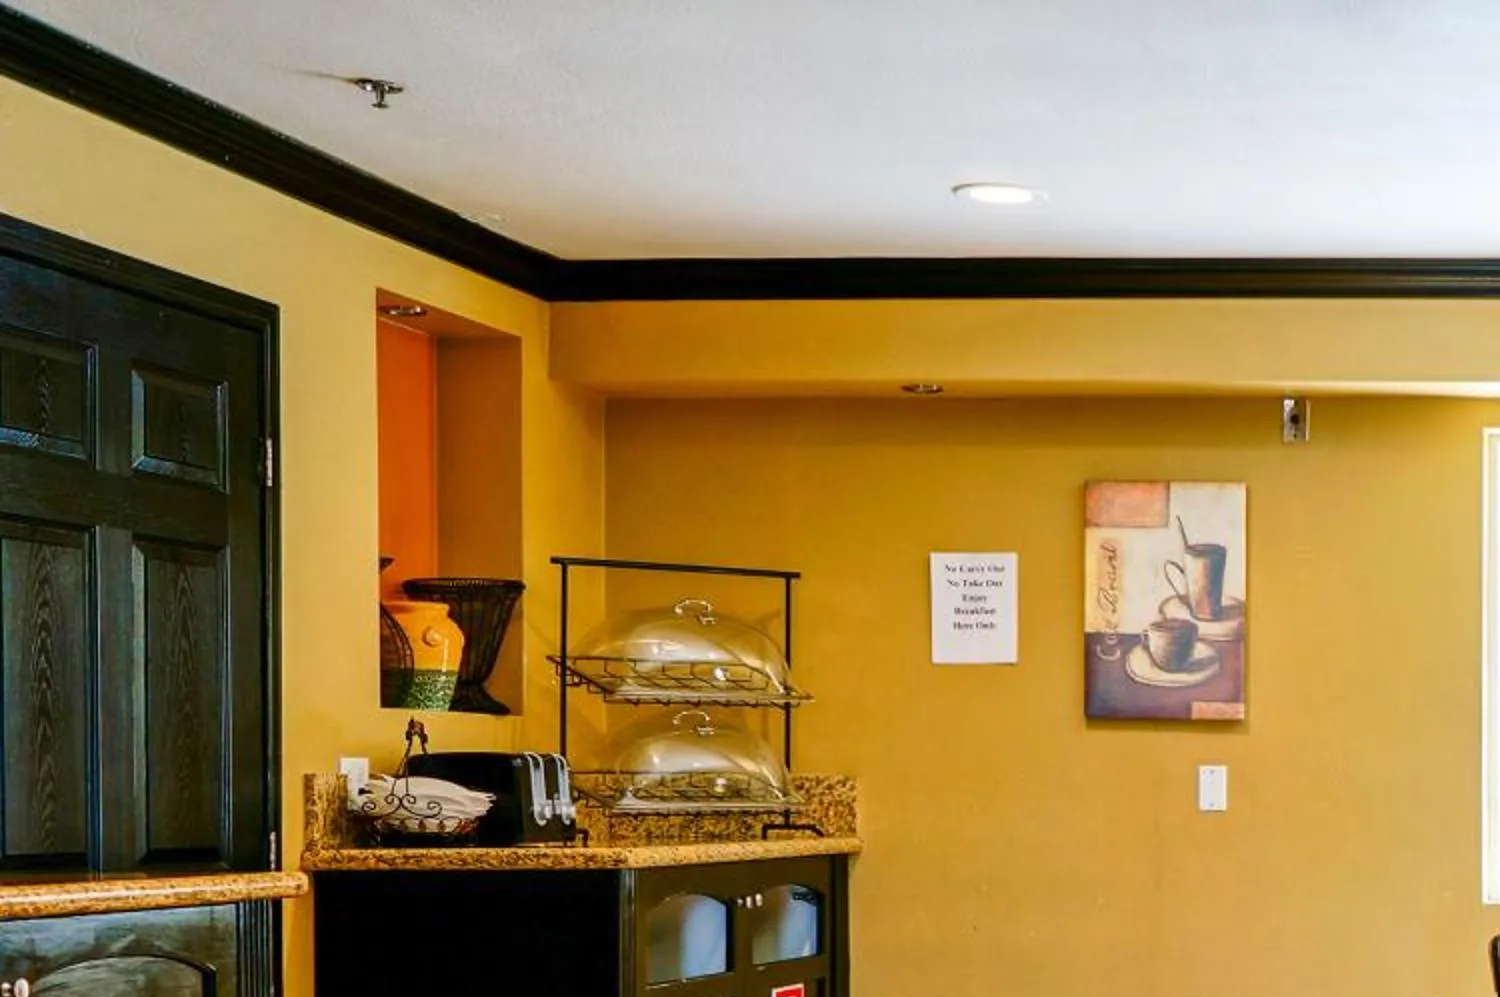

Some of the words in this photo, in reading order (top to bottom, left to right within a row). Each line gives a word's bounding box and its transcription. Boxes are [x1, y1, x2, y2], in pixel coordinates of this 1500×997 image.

[945, 564, 957, 573] No
[959, 565, 985, 574] Carry
[946, 579, 960, 587] No
[963, 579, 984, 587] Take
[985, 579, 1003, 587] Out
[962, 594, 987, 603] Enjoy
[953, 606, 997, 615] Breakfast
[953, 621, 973, 629] Here
